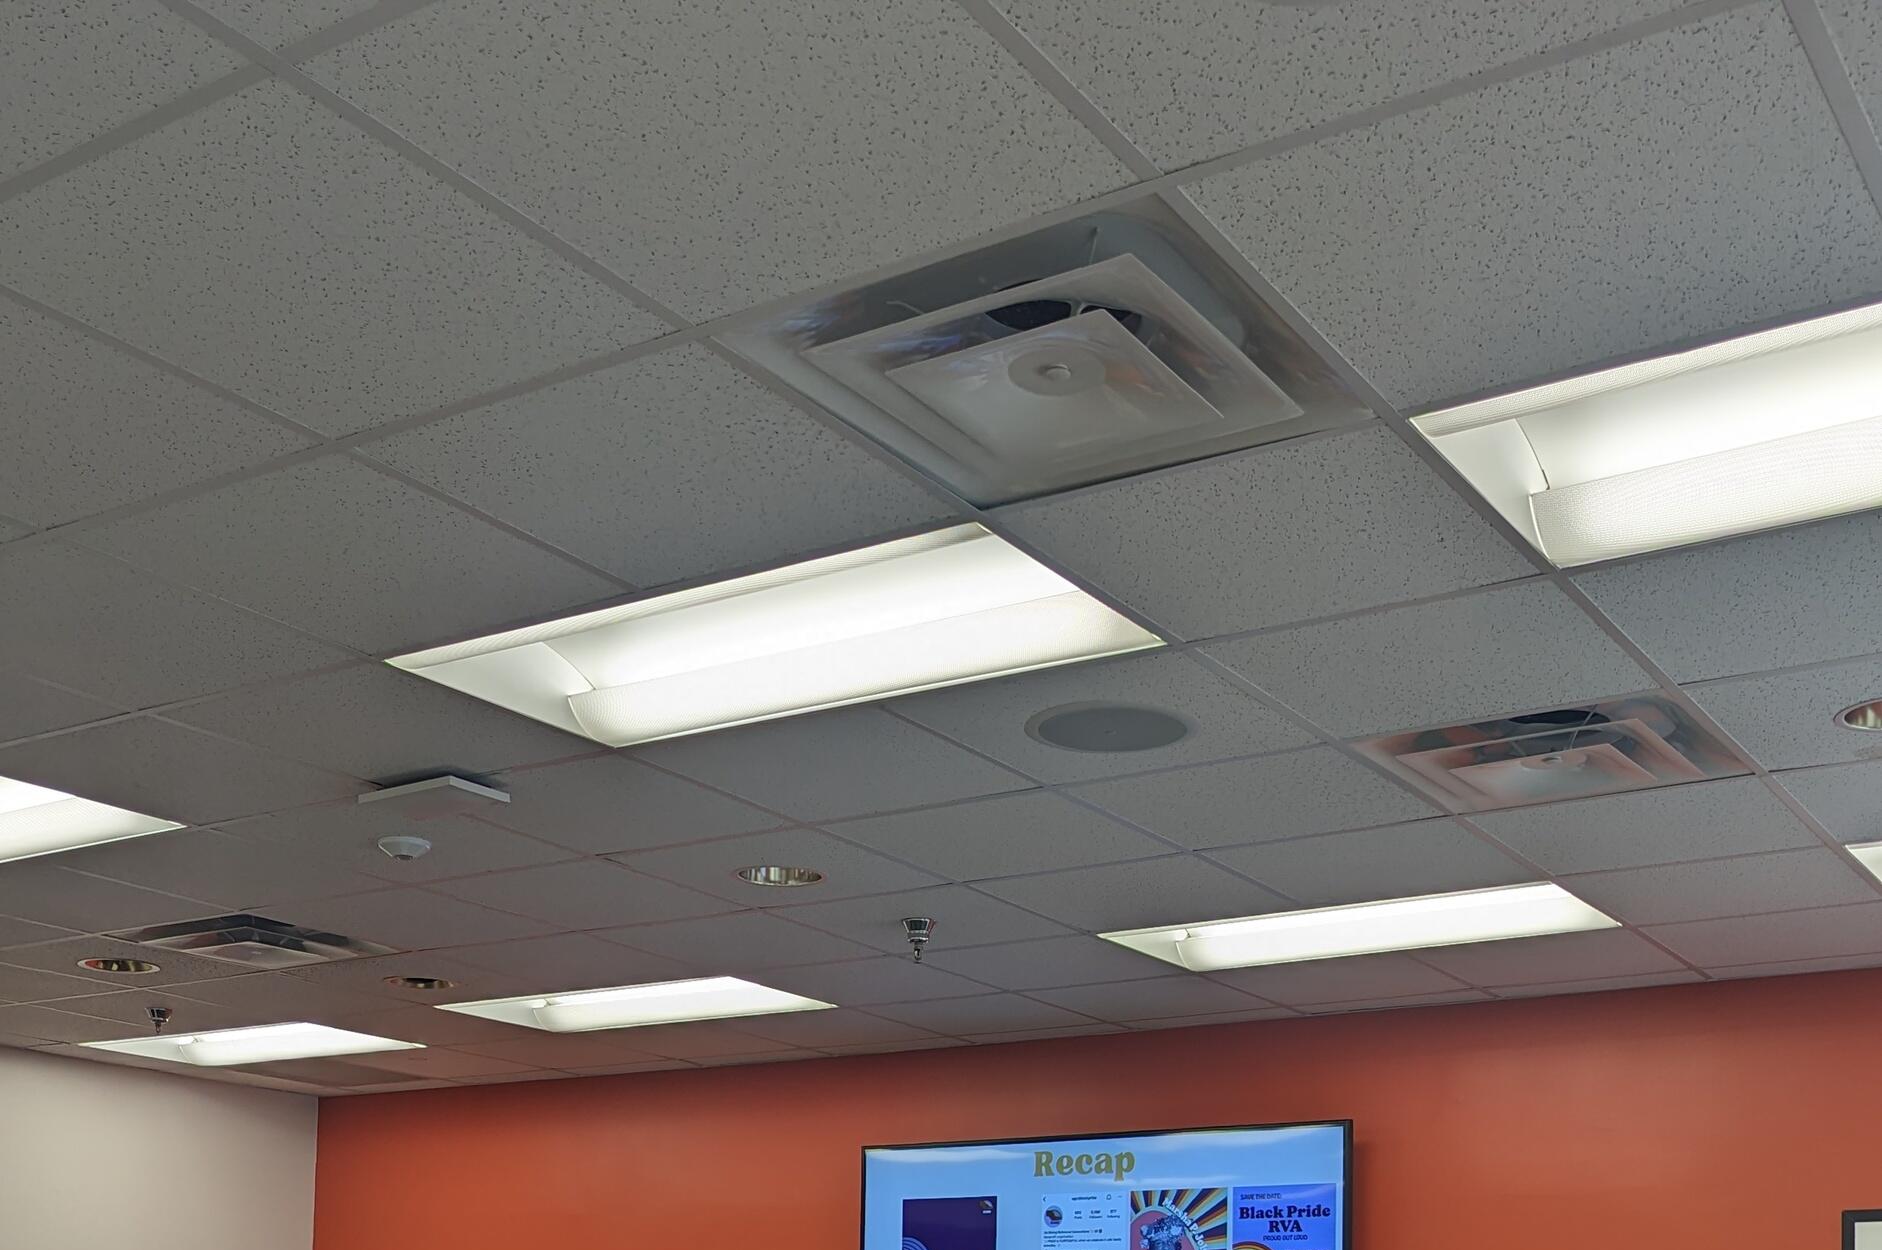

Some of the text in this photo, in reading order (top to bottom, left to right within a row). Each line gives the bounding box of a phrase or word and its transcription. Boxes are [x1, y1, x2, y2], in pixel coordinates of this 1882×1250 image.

[1033, 1151, 1136, 1181] Recap
[1162, 1197, 1192, 1227] Marsha
[1239, 1204, 1331, 1219] Black Pride
[1268, 1219, 1303, 1232] RVA
